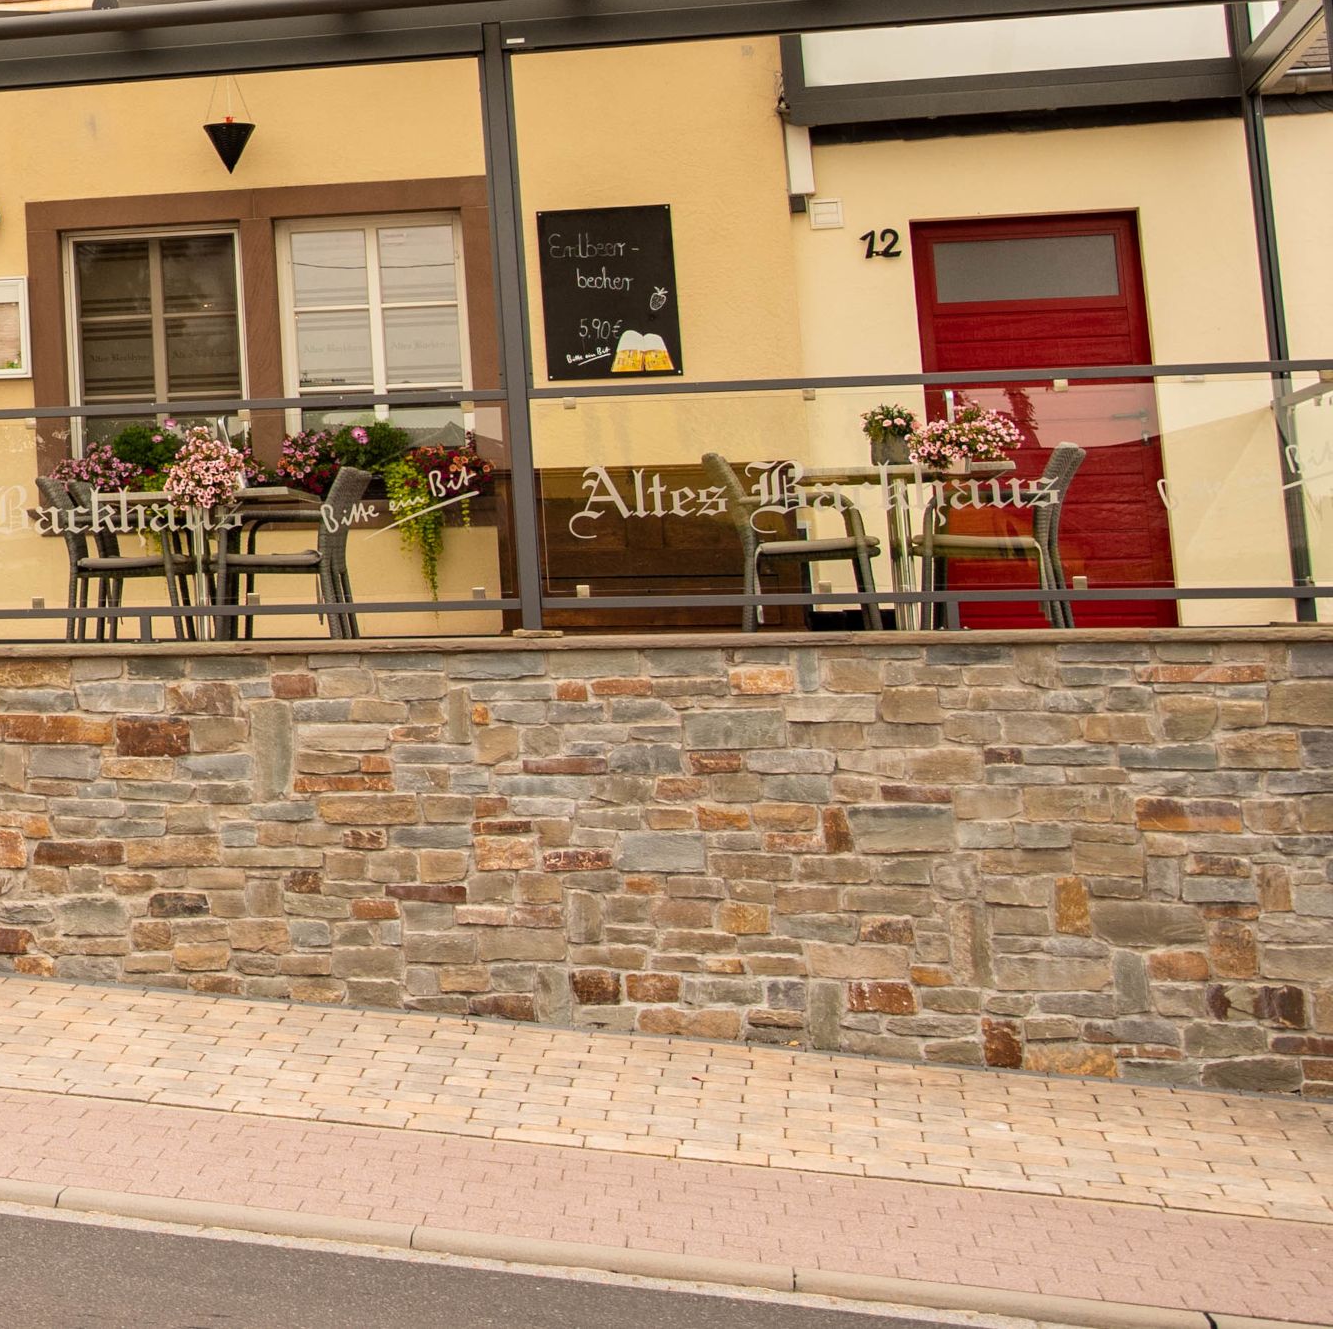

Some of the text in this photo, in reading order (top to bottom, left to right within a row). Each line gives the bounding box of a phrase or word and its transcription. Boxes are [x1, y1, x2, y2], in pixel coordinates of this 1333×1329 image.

[859, 228, 902, 259] 12
[576, 266, 634, 292] becher
[566, 353, 583, 364] Bitte
[596, 346, 611, 358] Bit
[320, 465, 476, 534] Bitte ein Bit
[569, 459, 1064, 539] Altes Backhaus
